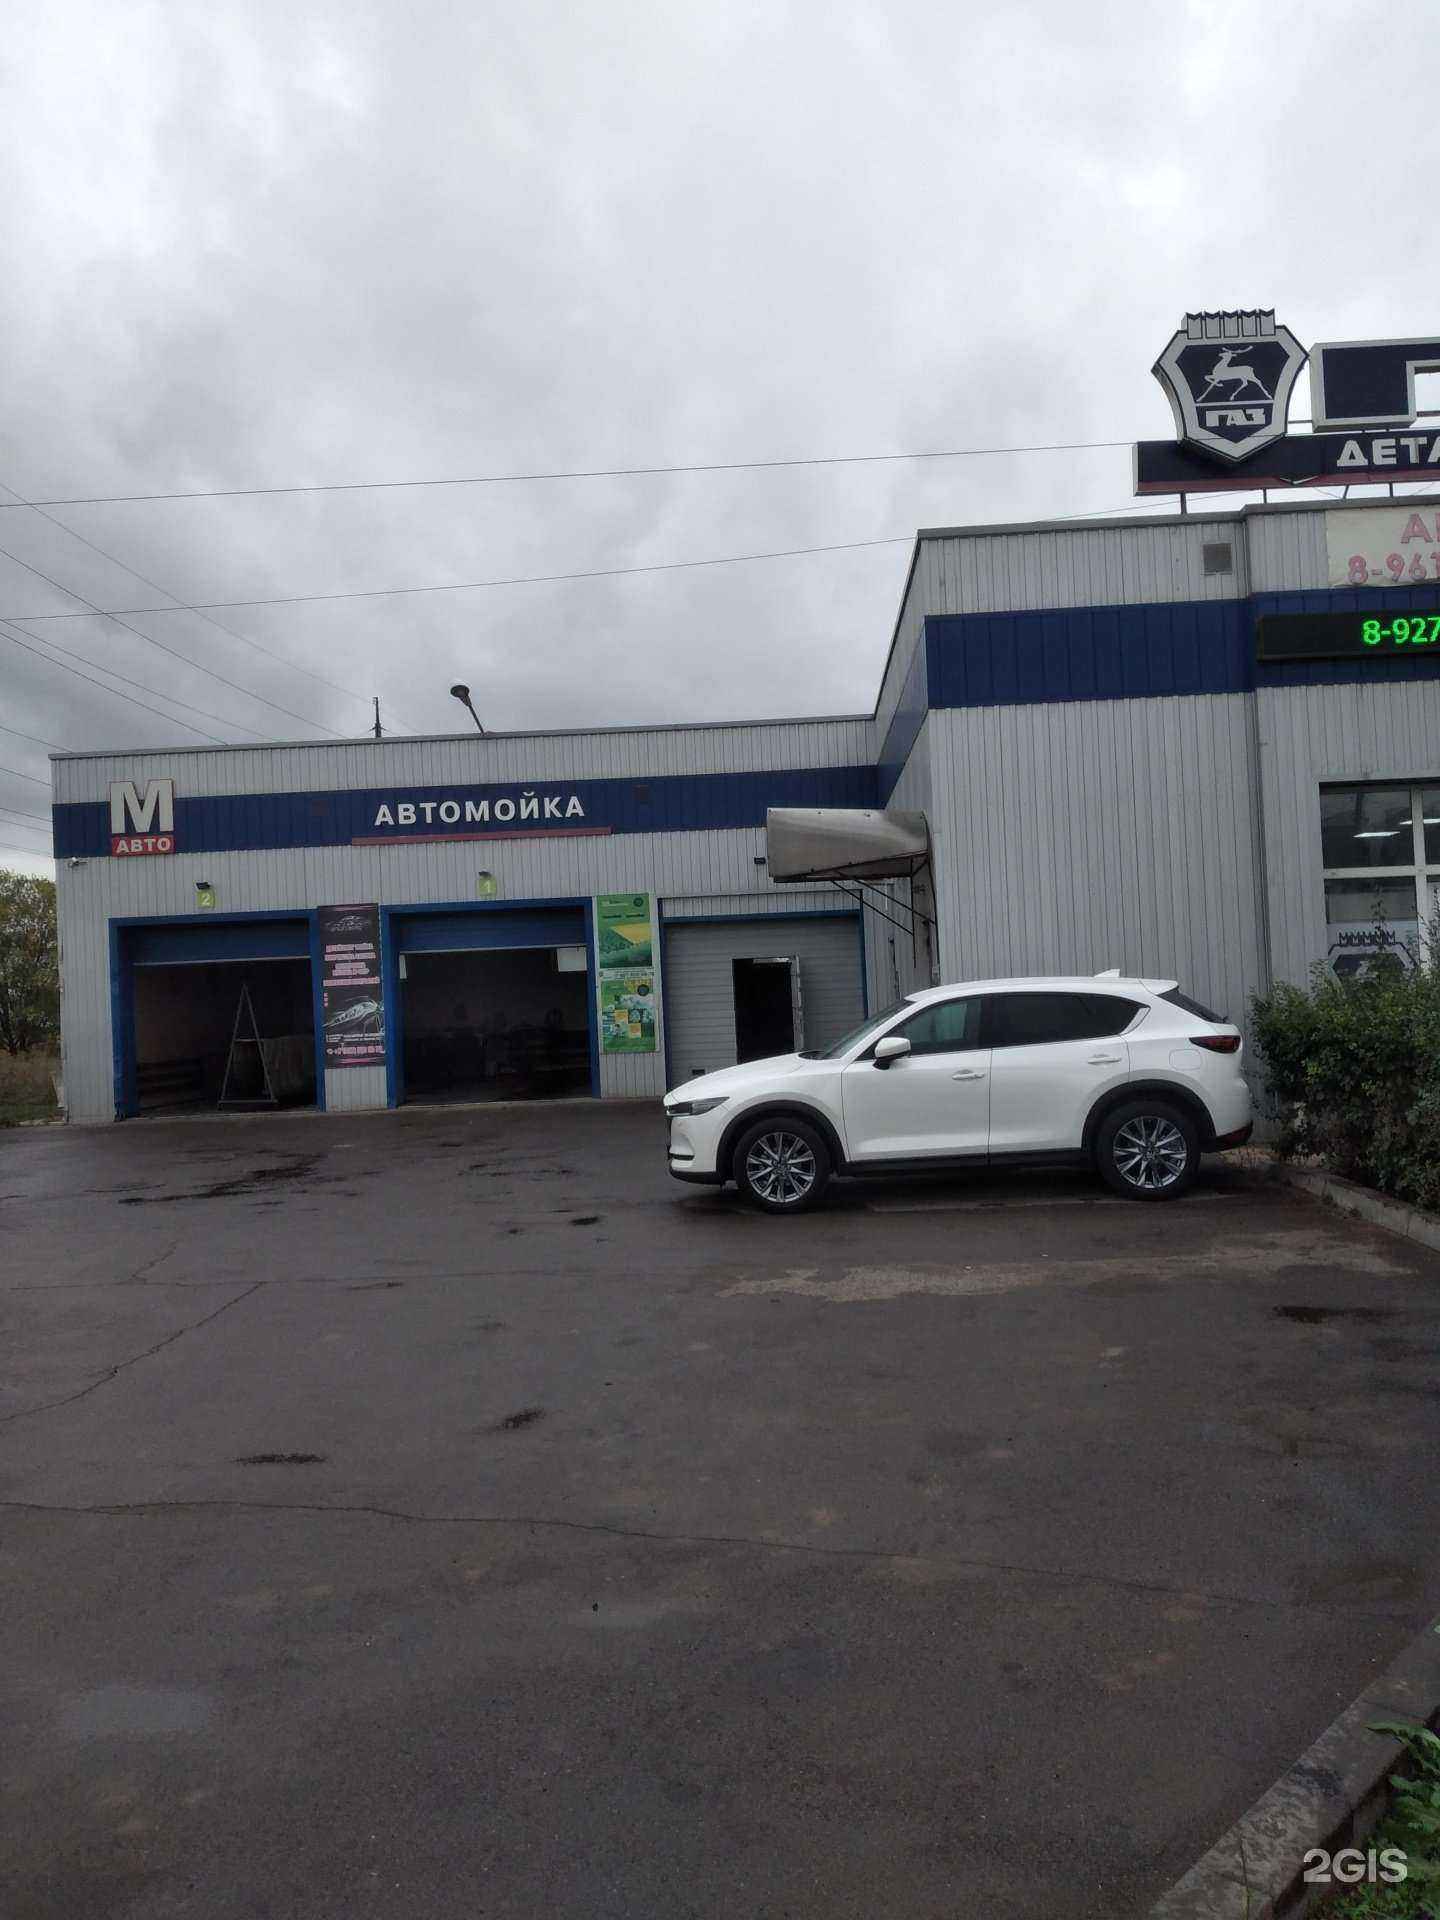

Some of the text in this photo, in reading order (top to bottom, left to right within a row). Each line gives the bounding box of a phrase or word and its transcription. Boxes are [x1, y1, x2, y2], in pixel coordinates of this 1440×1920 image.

[1205, 408, 1266, 427] ГАЗ
[1400, 512, 1440, 544] А
[1362, 616, 1440, 645] 8-927
[110, 780, 174, 834] М
[374, 790, 585, 826] АВТОМОЙКА
[116, 837, 171, 853] АВТО
[483, 880, 492, 894] 1
[201, 893, 211, 906] 2
